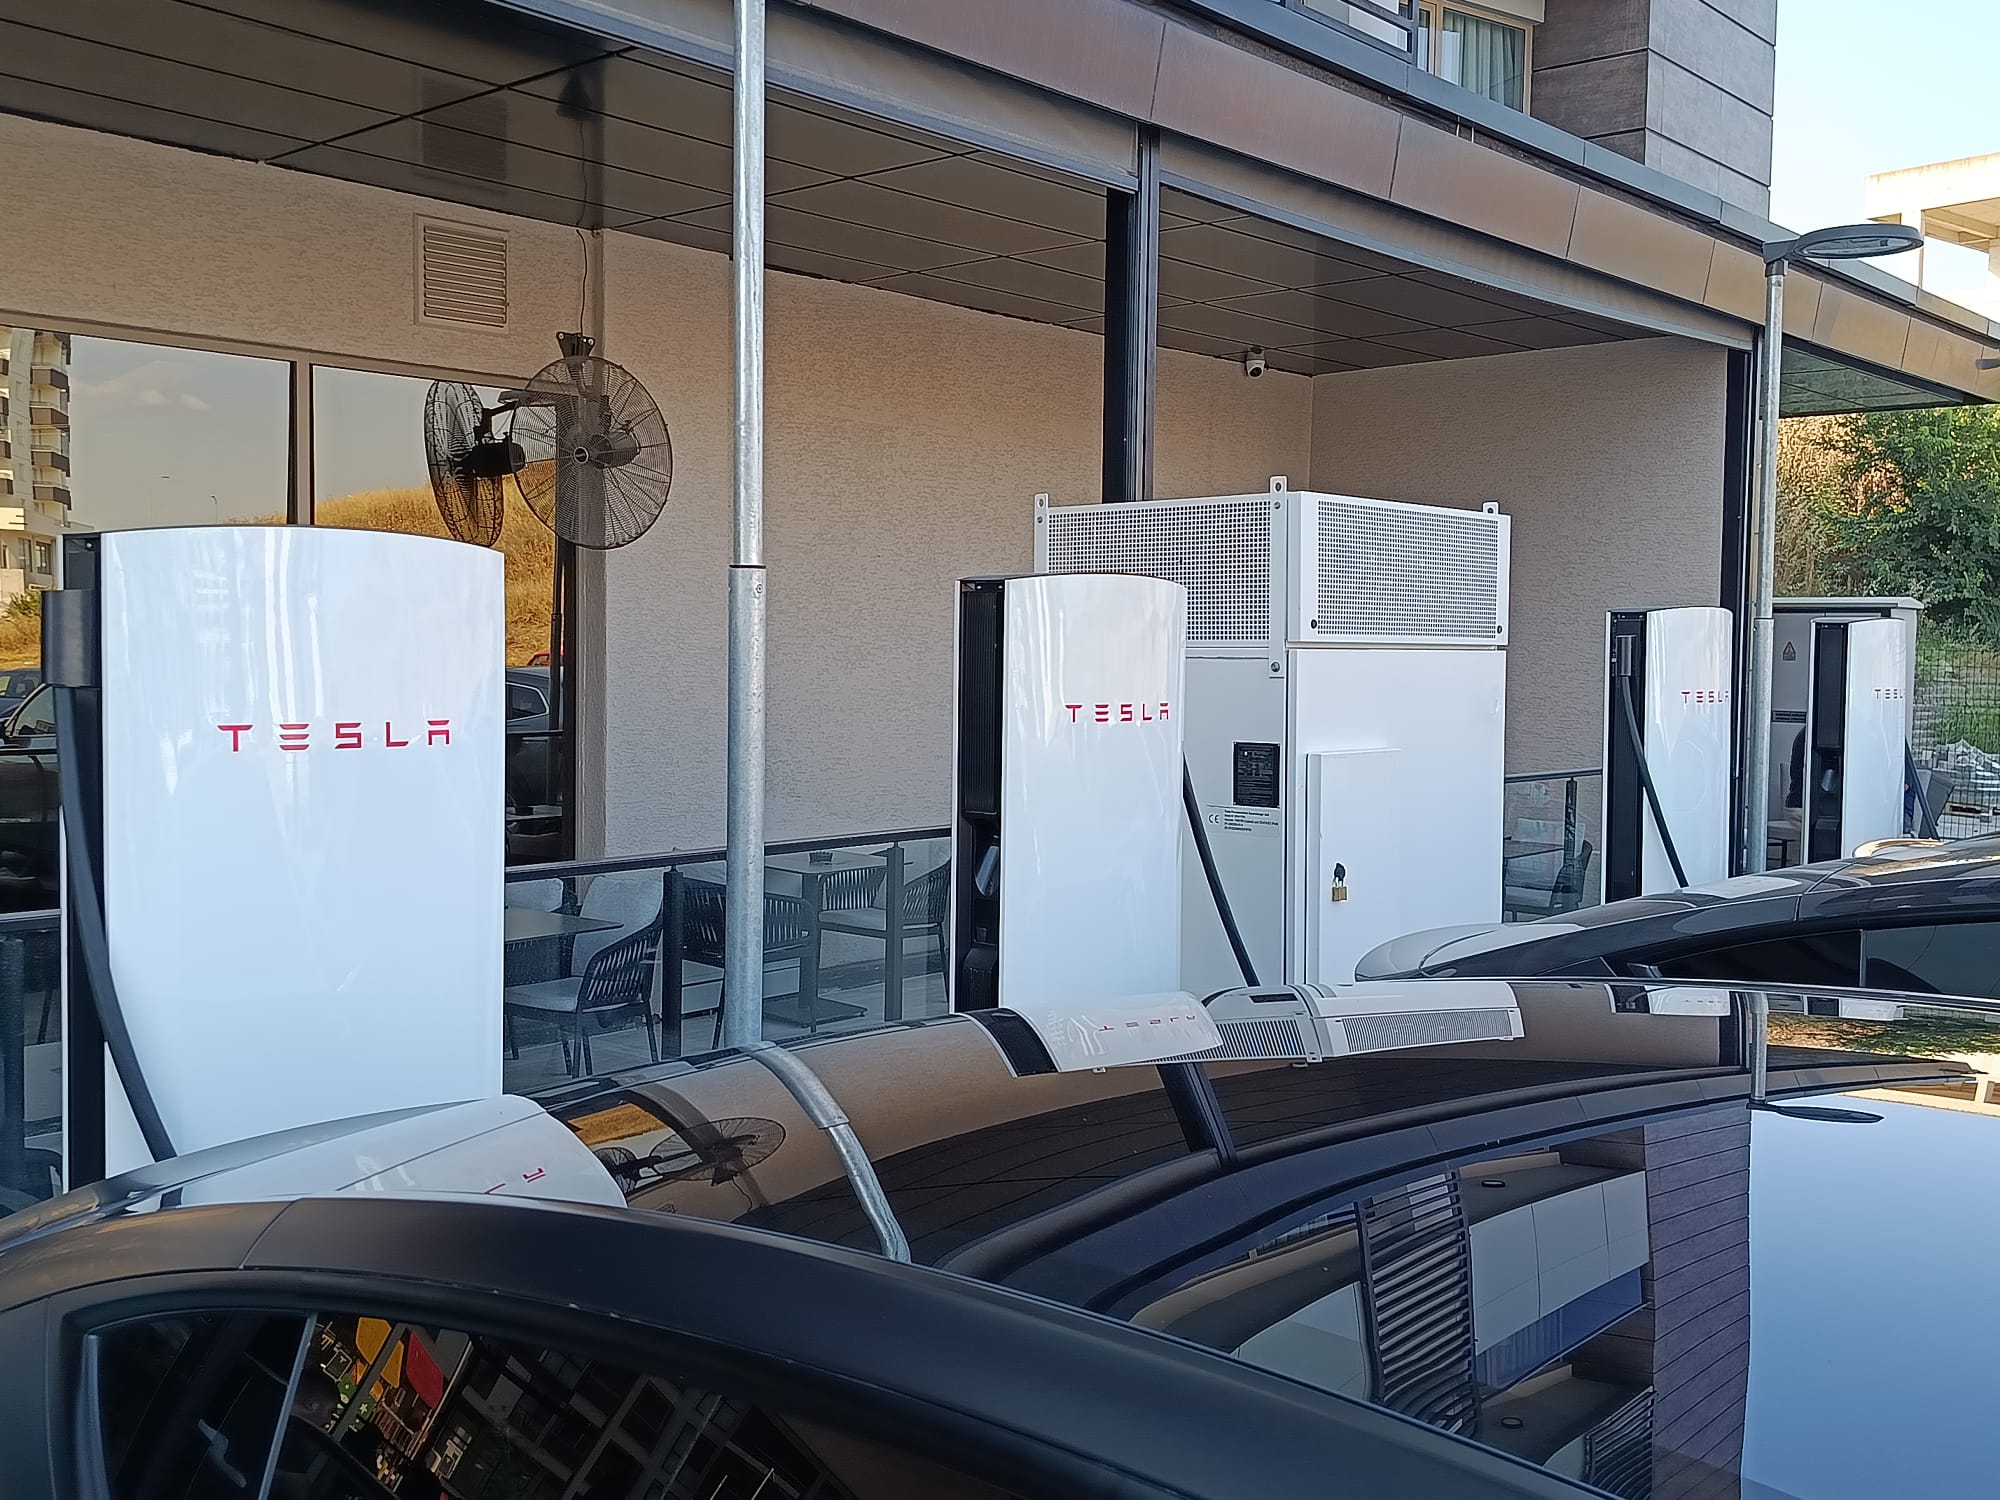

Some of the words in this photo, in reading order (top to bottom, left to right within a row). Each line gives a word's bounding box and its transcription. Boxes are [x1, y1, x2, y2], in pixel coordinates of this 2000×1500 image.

[1874, 688, 1904, 700] TESL
[1064, 702, 1169, 723] TESLA
[217, 719, 450, 752] TESLA
[1208, 814, 1220, 824] CE
